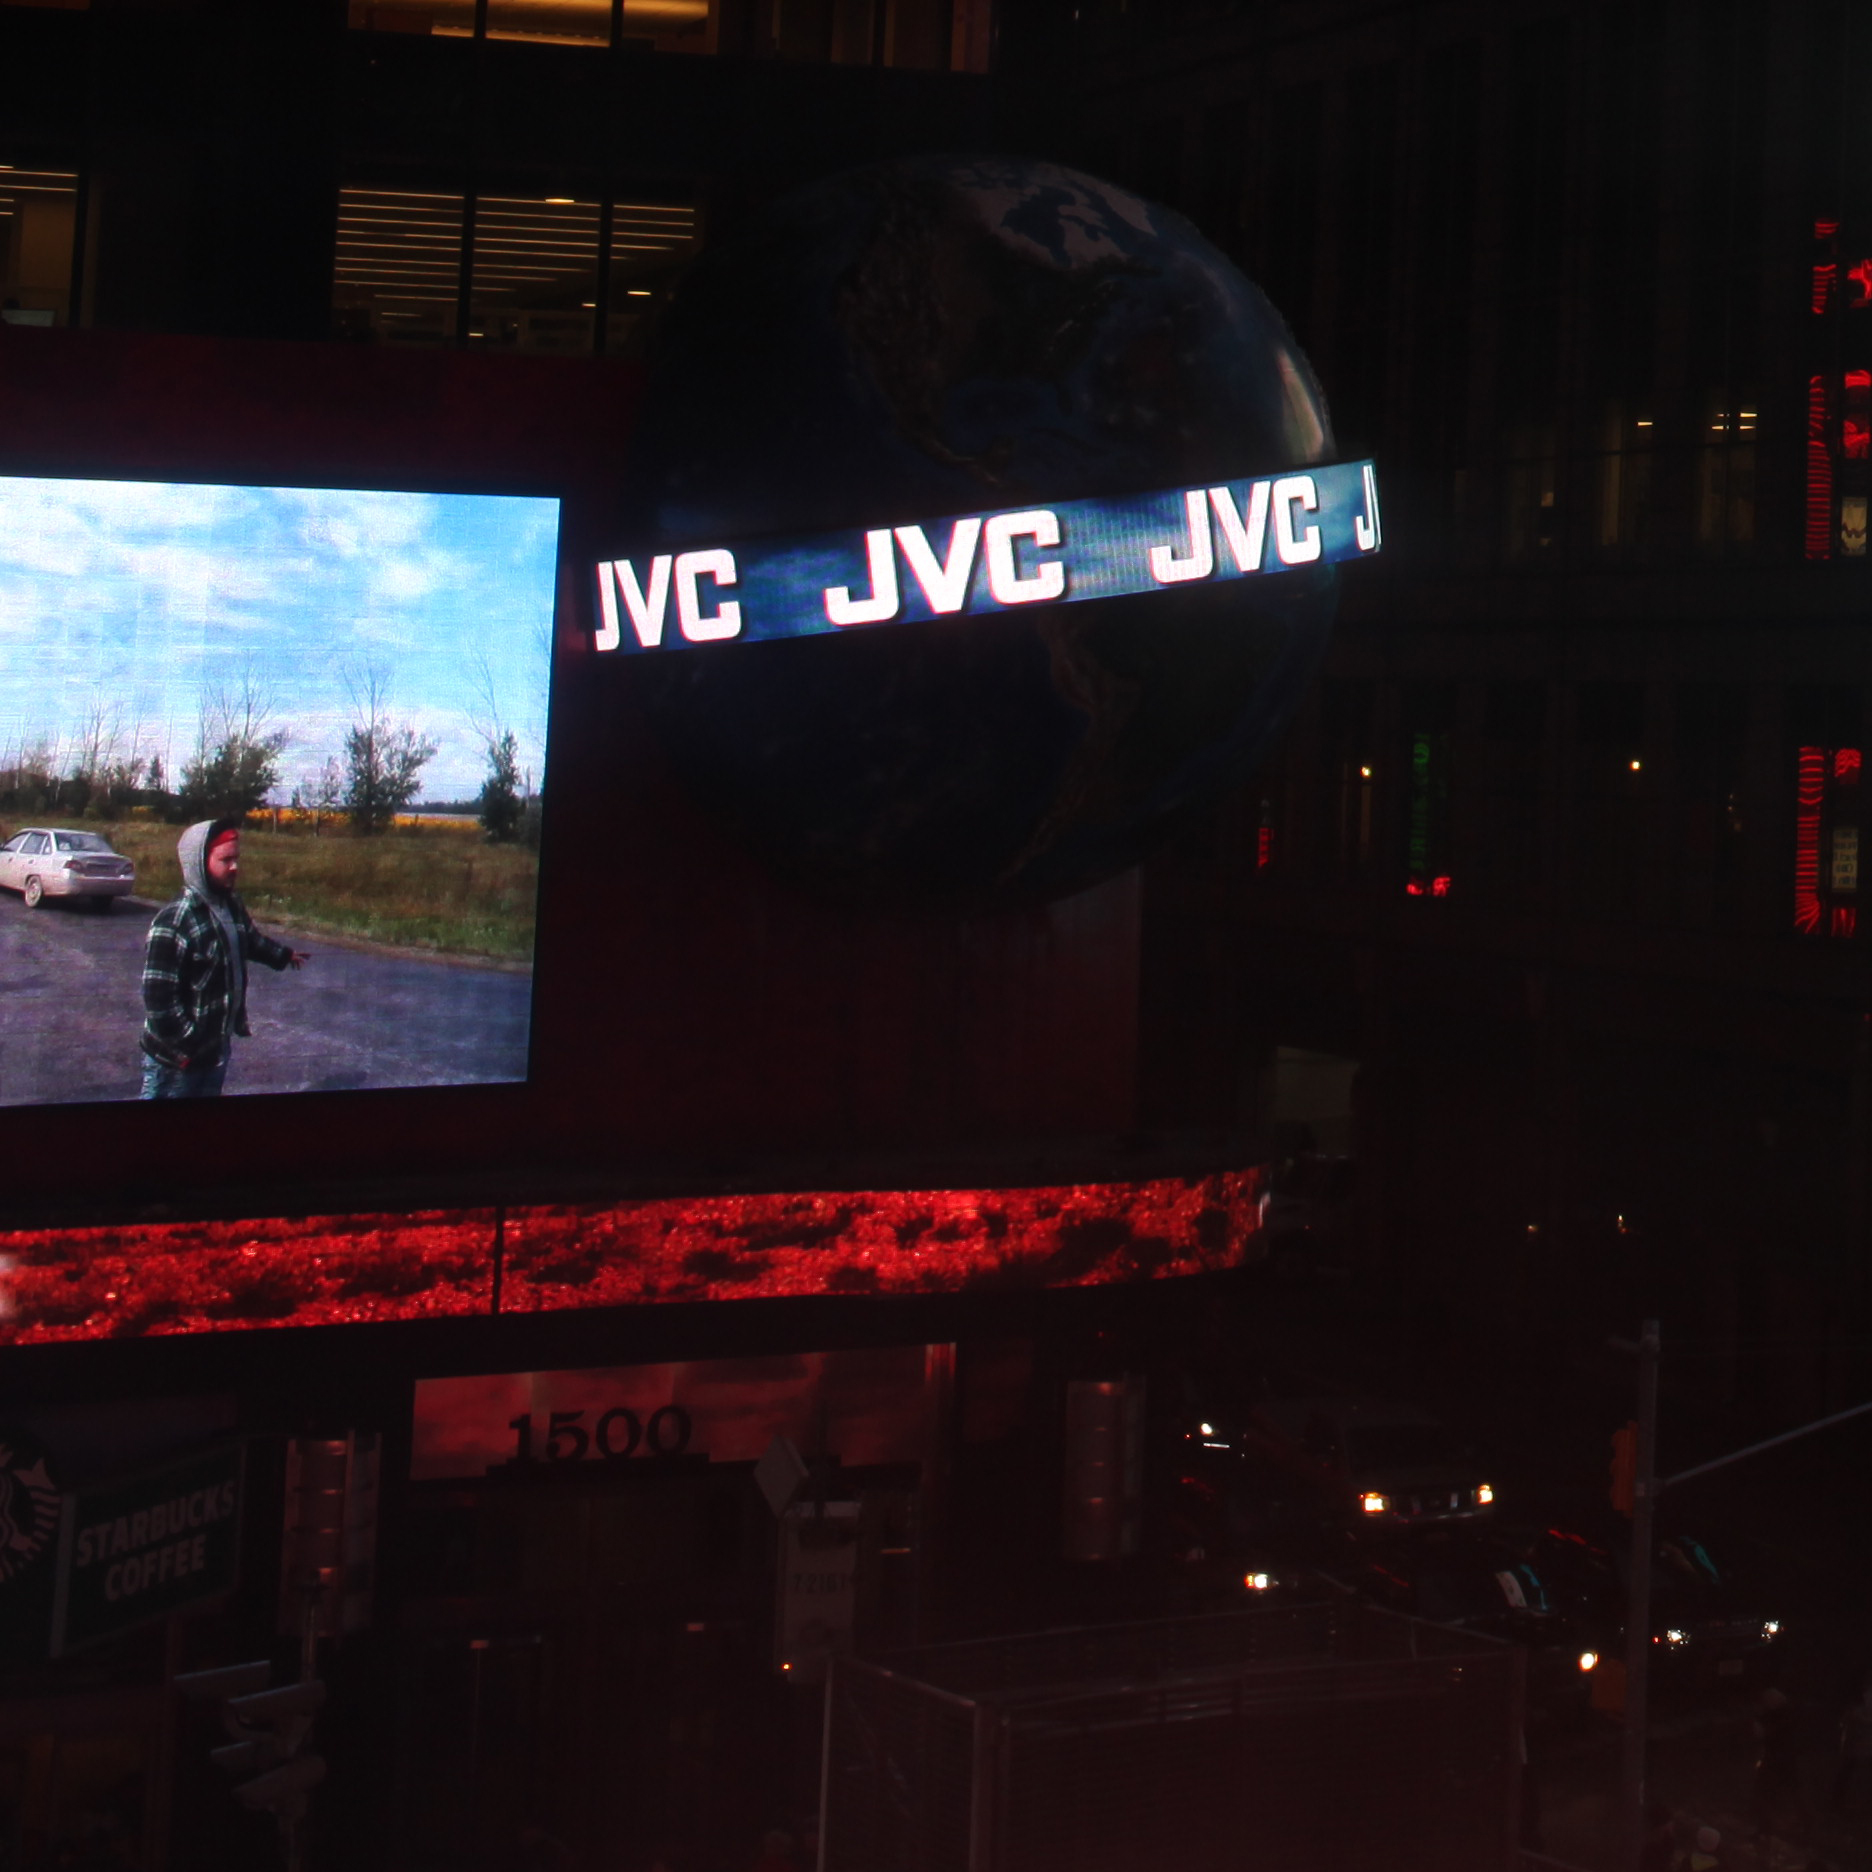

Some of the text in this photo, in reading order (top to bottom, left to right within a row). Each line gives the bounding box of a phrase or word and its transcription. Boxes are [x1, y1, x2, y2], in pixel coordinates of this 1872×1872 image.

[824, 509, 1066, 626] JVC
[1150, 474, 1322, 585] JVC
[1355, 464, 1383, 552] J
[508, 1405, 692, 1464] 1500
[76, 1479, 236, 1568] STARBUCKS
[105, 1534, 207, 1602] COFFEE
